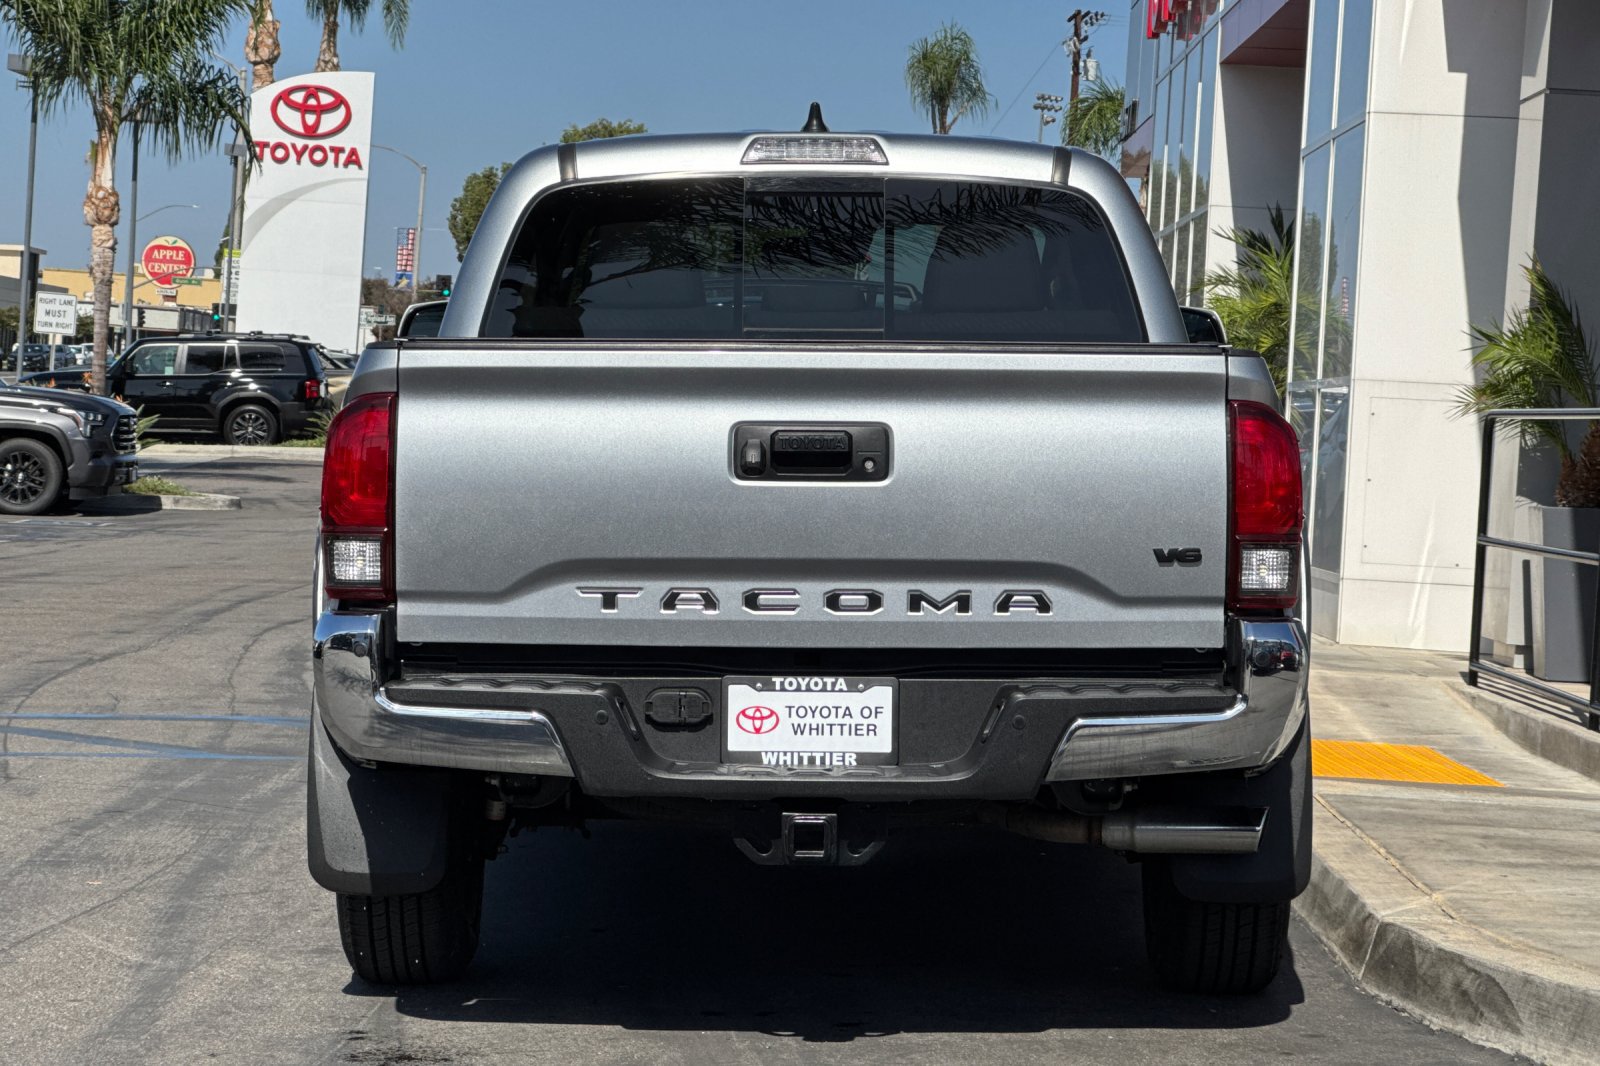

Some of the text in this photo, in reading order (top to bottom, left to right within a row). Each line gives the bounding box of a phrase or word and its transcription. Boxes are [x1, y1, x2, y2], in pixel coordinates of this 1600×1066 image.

[253, 140, 363, 170] TOYOTA
[152, 249, 185, 260] APPLE
[148, 262, 187, 274] CENTER
[39, 297, 74, 306] RIGHT LANE
[44, 309, 67, 318] MUST
[37, 320, 73, 330] TURN RIGHT
[779, 435, 847, 450] TOYOTA
[1152, 547, 1203, 566] V6
[575, 586, 1055, 616] TACOMA
[771, 677, 848, 692] TOYOTA
[785, 705, 884, 719] TOYOTA OF
[791, 723, 878, 737] WHITTIER
[761, 752, 857, 766] WHITTIER
